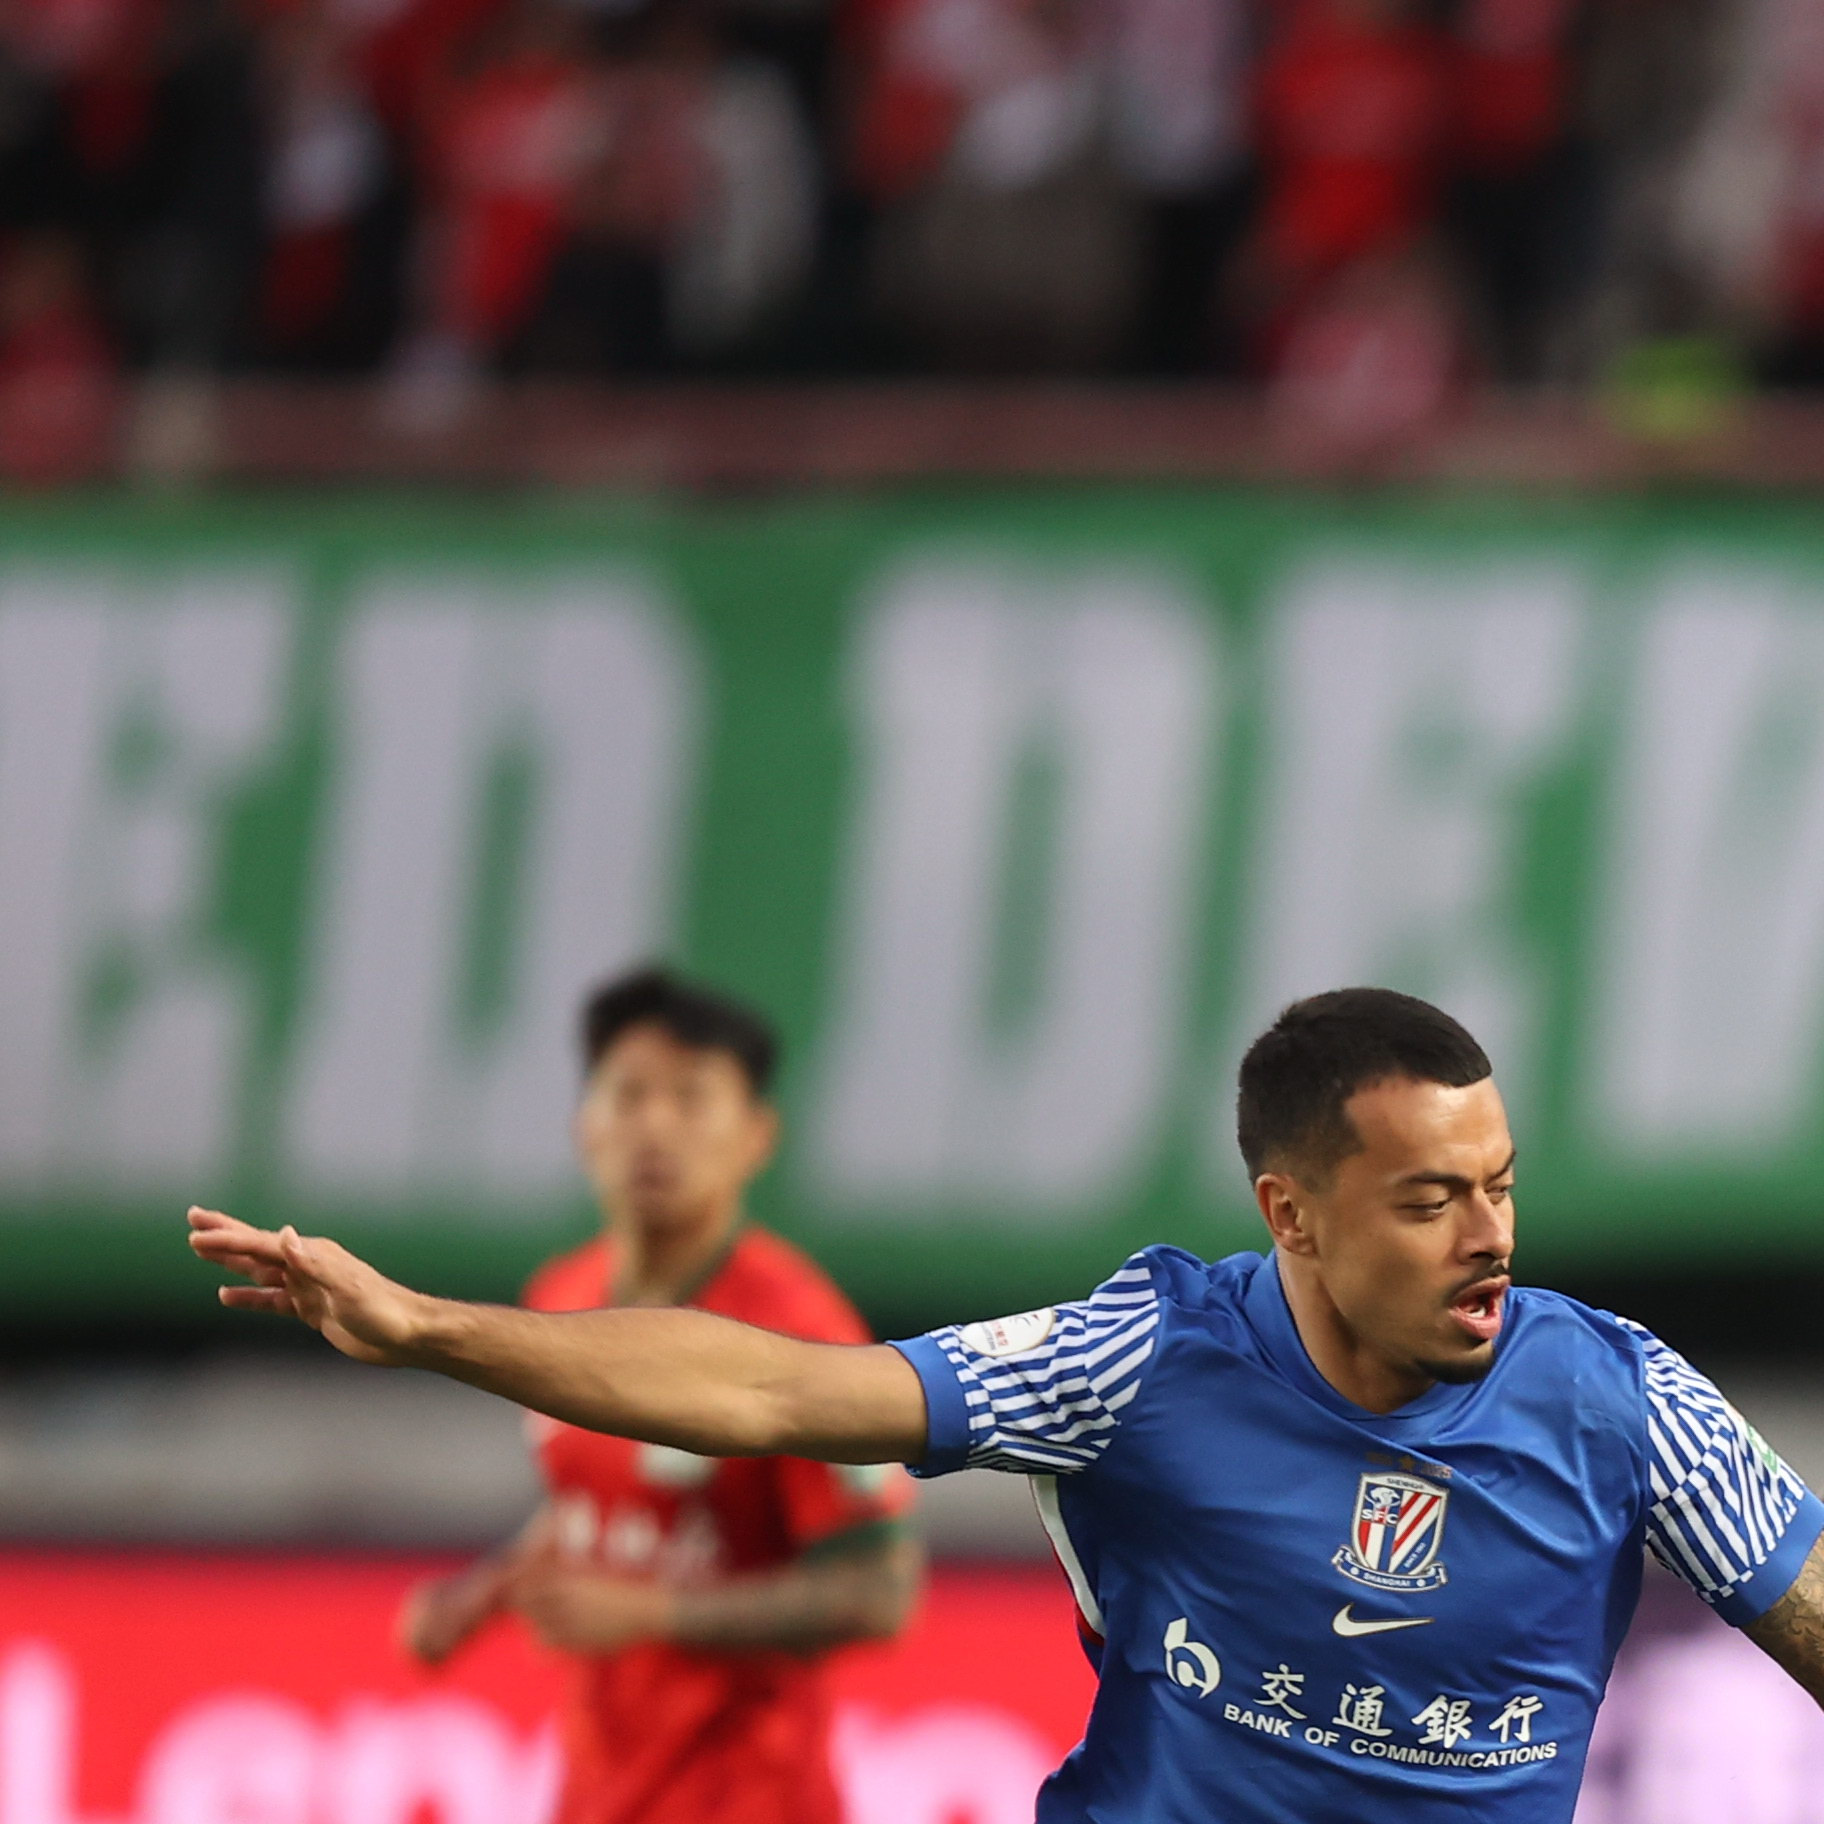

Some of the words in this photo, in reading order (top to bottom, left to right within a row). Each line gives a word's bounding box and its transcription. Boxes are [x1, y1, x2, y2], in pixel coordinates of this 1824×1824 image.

[1360, 1508, 1399, 1525] SFC
[1362, 1572, 1411, 1587] SHANGHAI
[1252, 1663, 1544, 1749] 交通銀行
[1223, 1702, 1294, 1738] BANK
[1303, 1726, 1341, 1748] OF
[1350, 1738, 1558, 1769] COMMUNICATIONS
